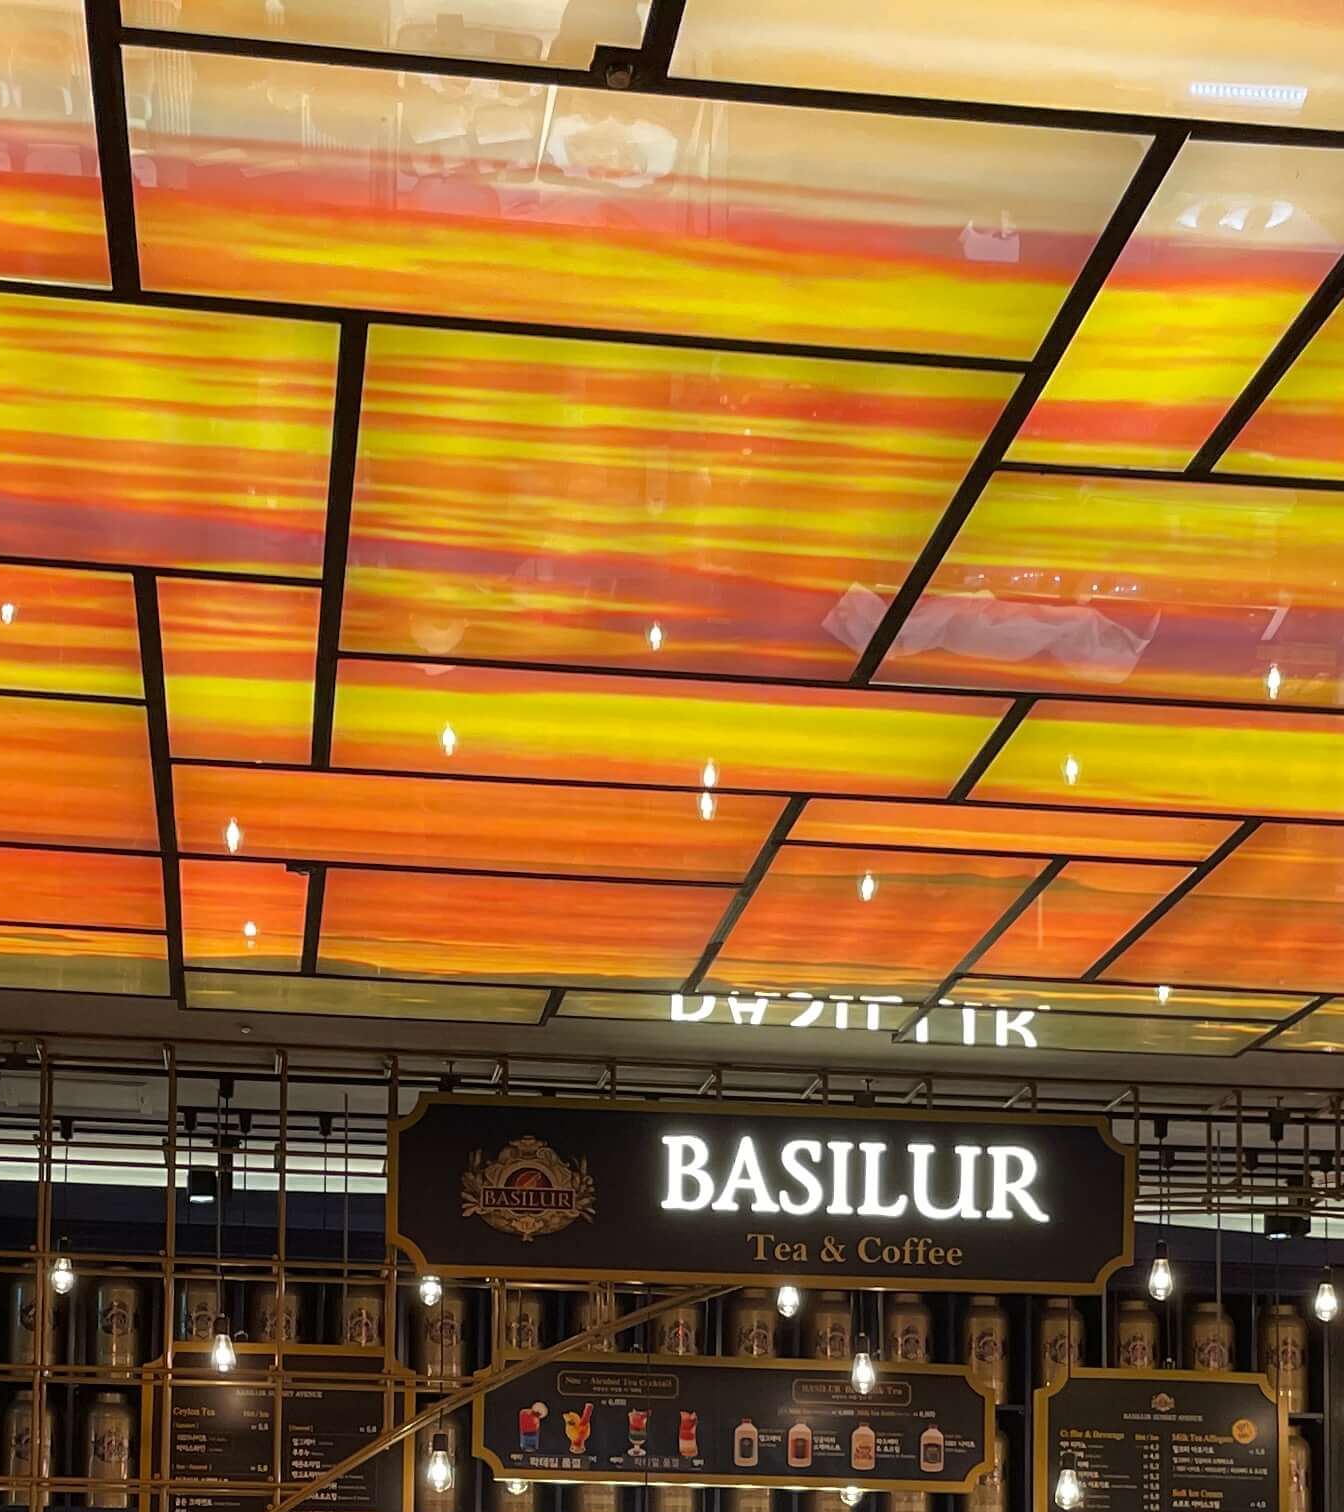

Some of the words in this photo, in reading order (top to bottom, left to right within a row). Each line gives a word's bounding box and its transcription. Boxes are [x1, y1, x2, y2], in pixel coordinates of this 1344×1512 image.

[660, 1135, 1051, 1223] BASILUR
[484, 1190, 572, 1208] BASILUR
[746, 1232, 808, 1262] Tea
[819, 1236, 847, 1263] &
[858, 1237, 964, 1266] Coffee
